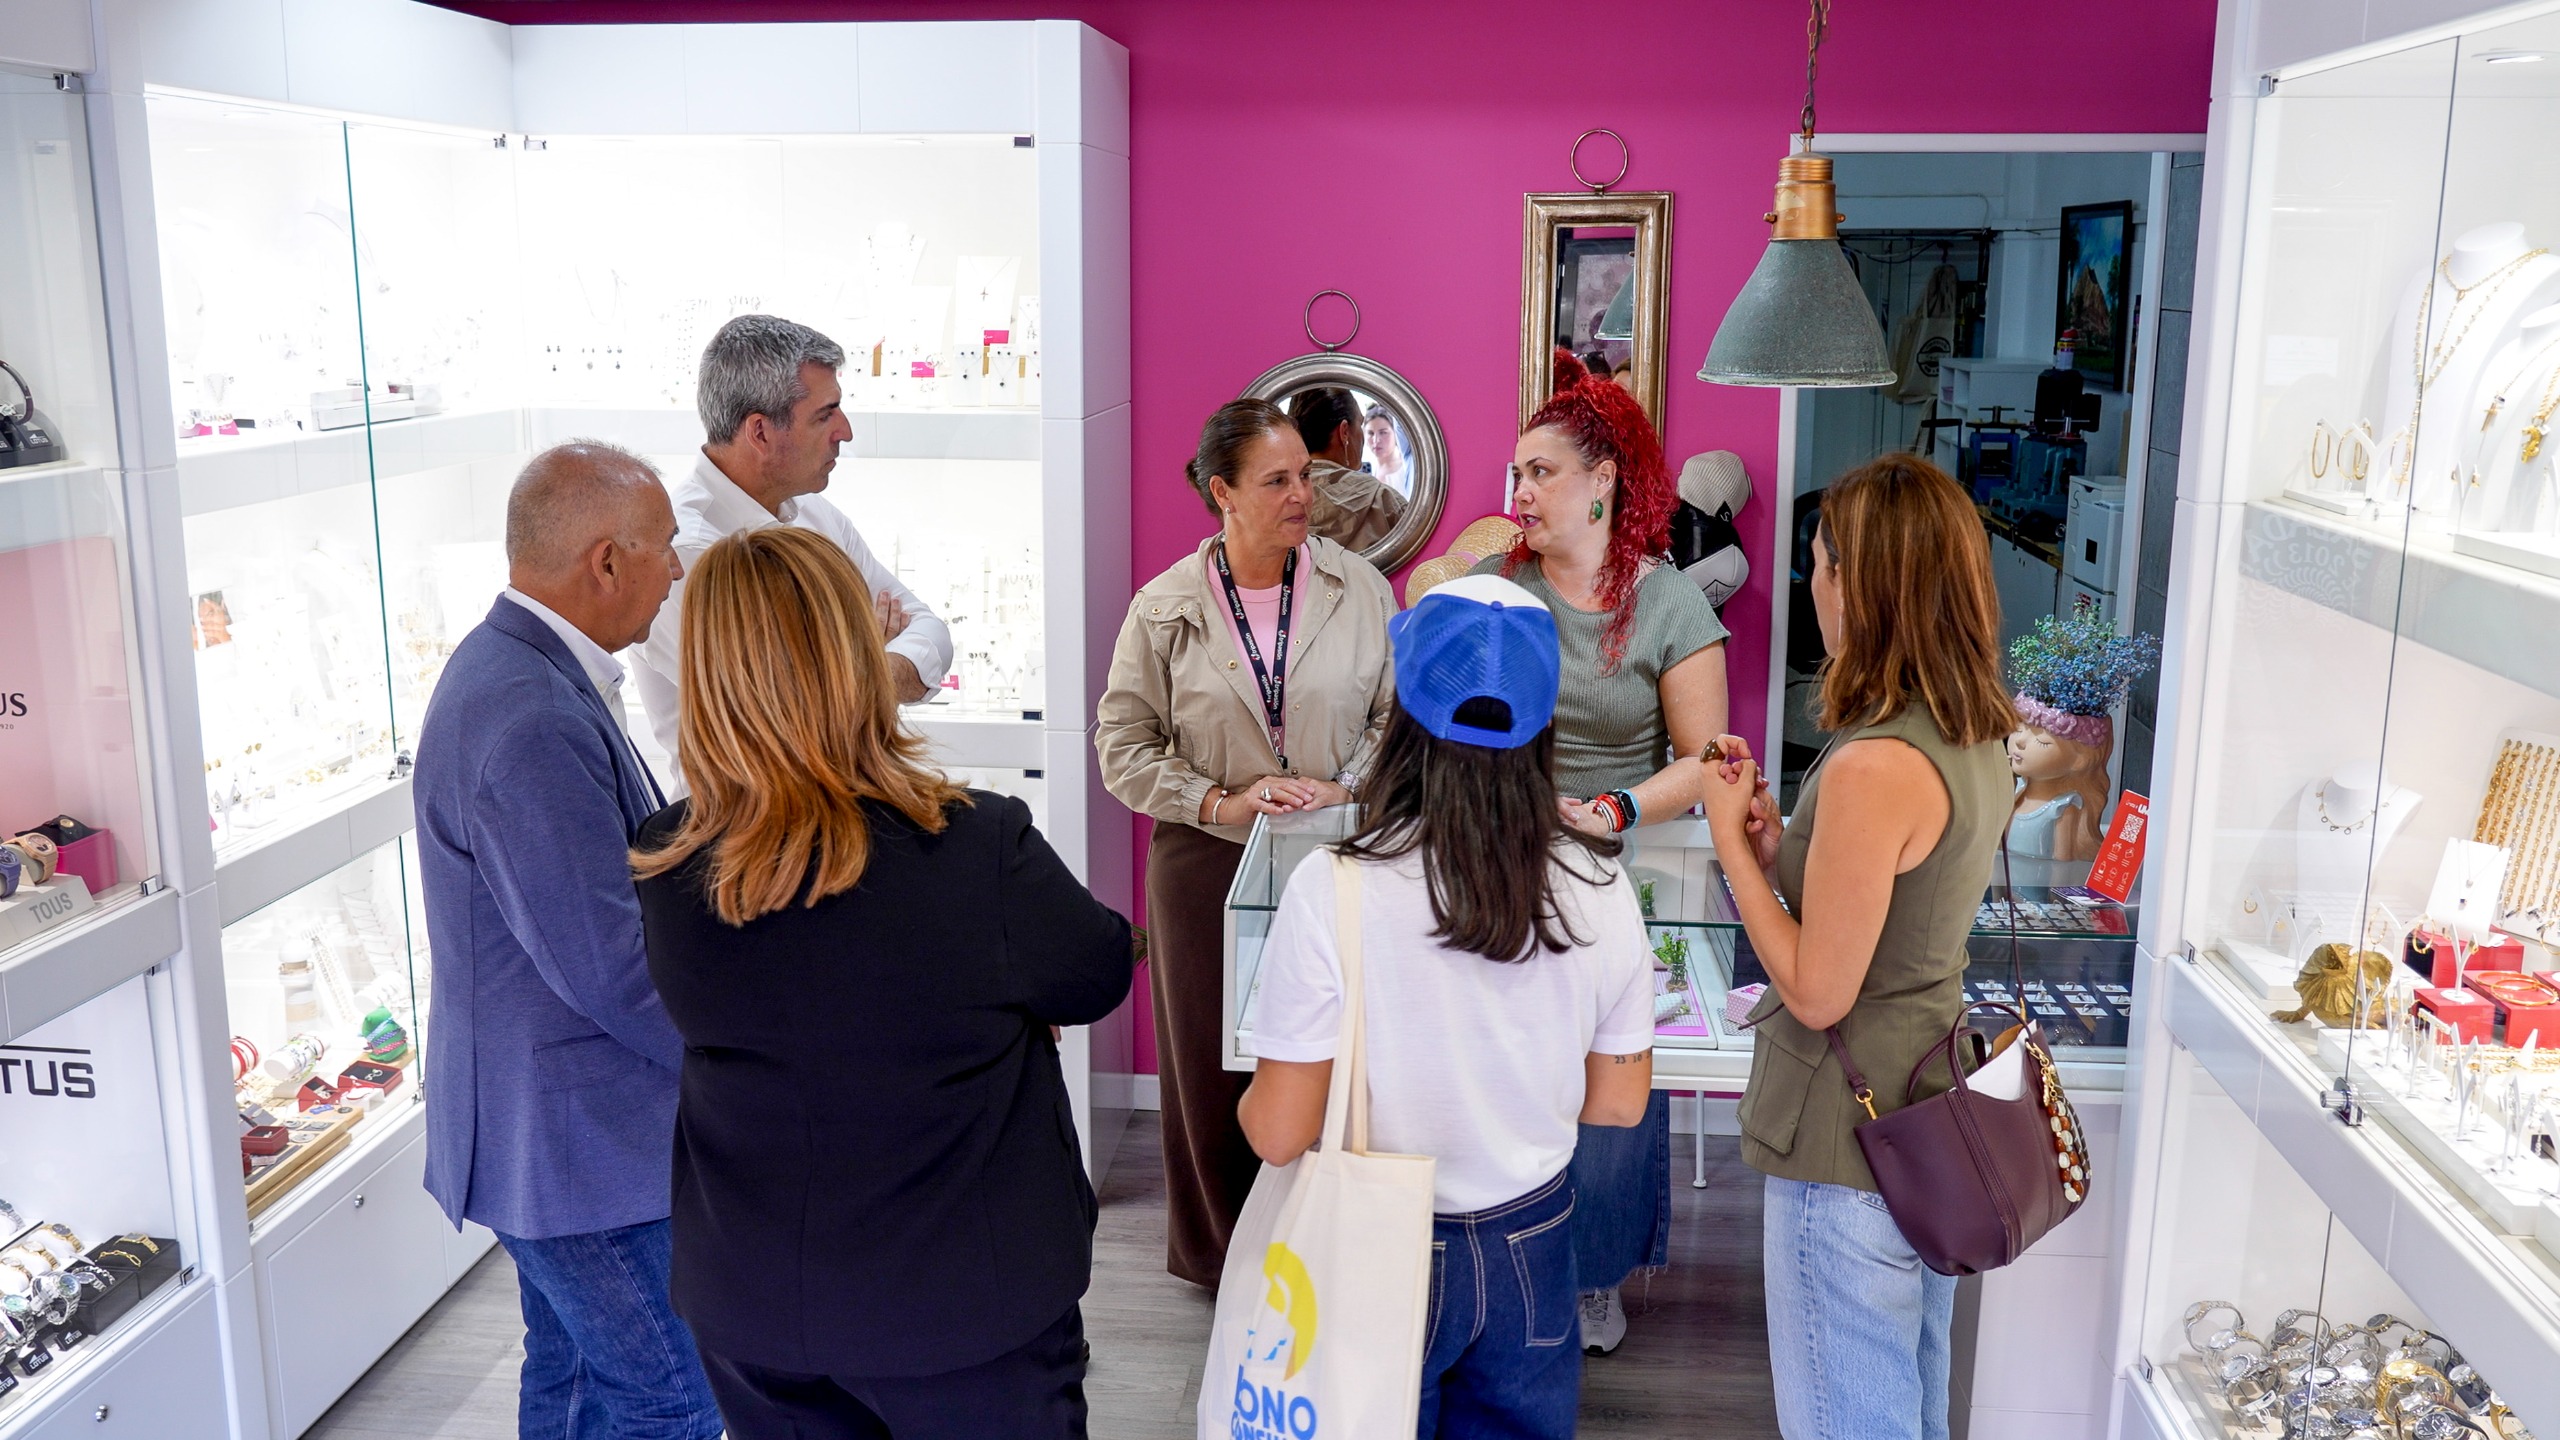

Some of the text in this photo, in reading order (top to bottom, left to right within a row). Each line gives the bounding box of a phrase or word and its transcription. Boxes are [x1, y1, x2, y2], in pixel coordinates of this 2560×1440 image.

[28, 892, 74, 924] TOUS
[65, 1330, 82, 1345] LOTUS
[29, 1354, 49, 1369] LOTUS
